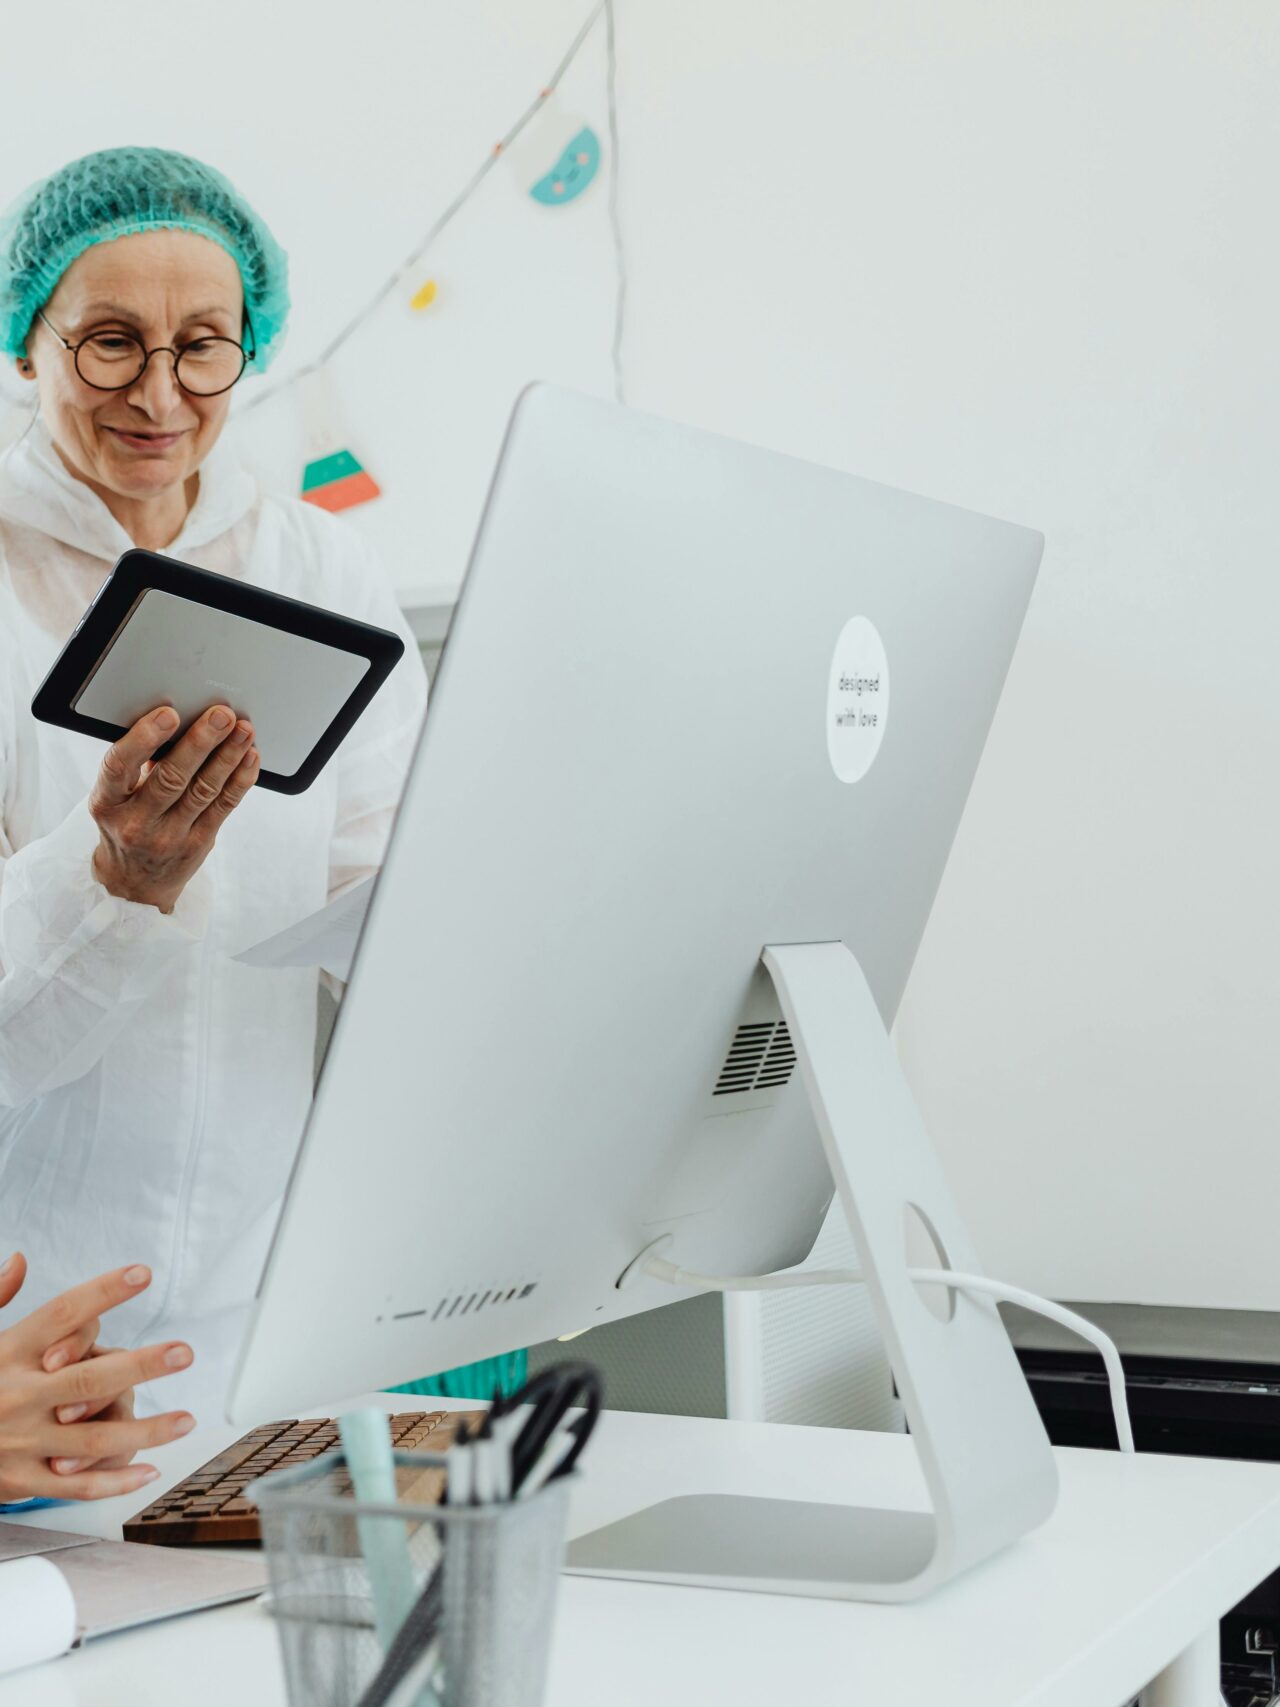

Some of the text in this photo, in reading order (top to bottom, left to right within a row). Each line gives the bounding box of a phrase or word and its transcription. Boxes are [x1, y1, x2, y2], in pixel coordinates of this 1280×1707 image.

[839, 672, 880, 696] designed
[836, 706, 878, 727] with love
